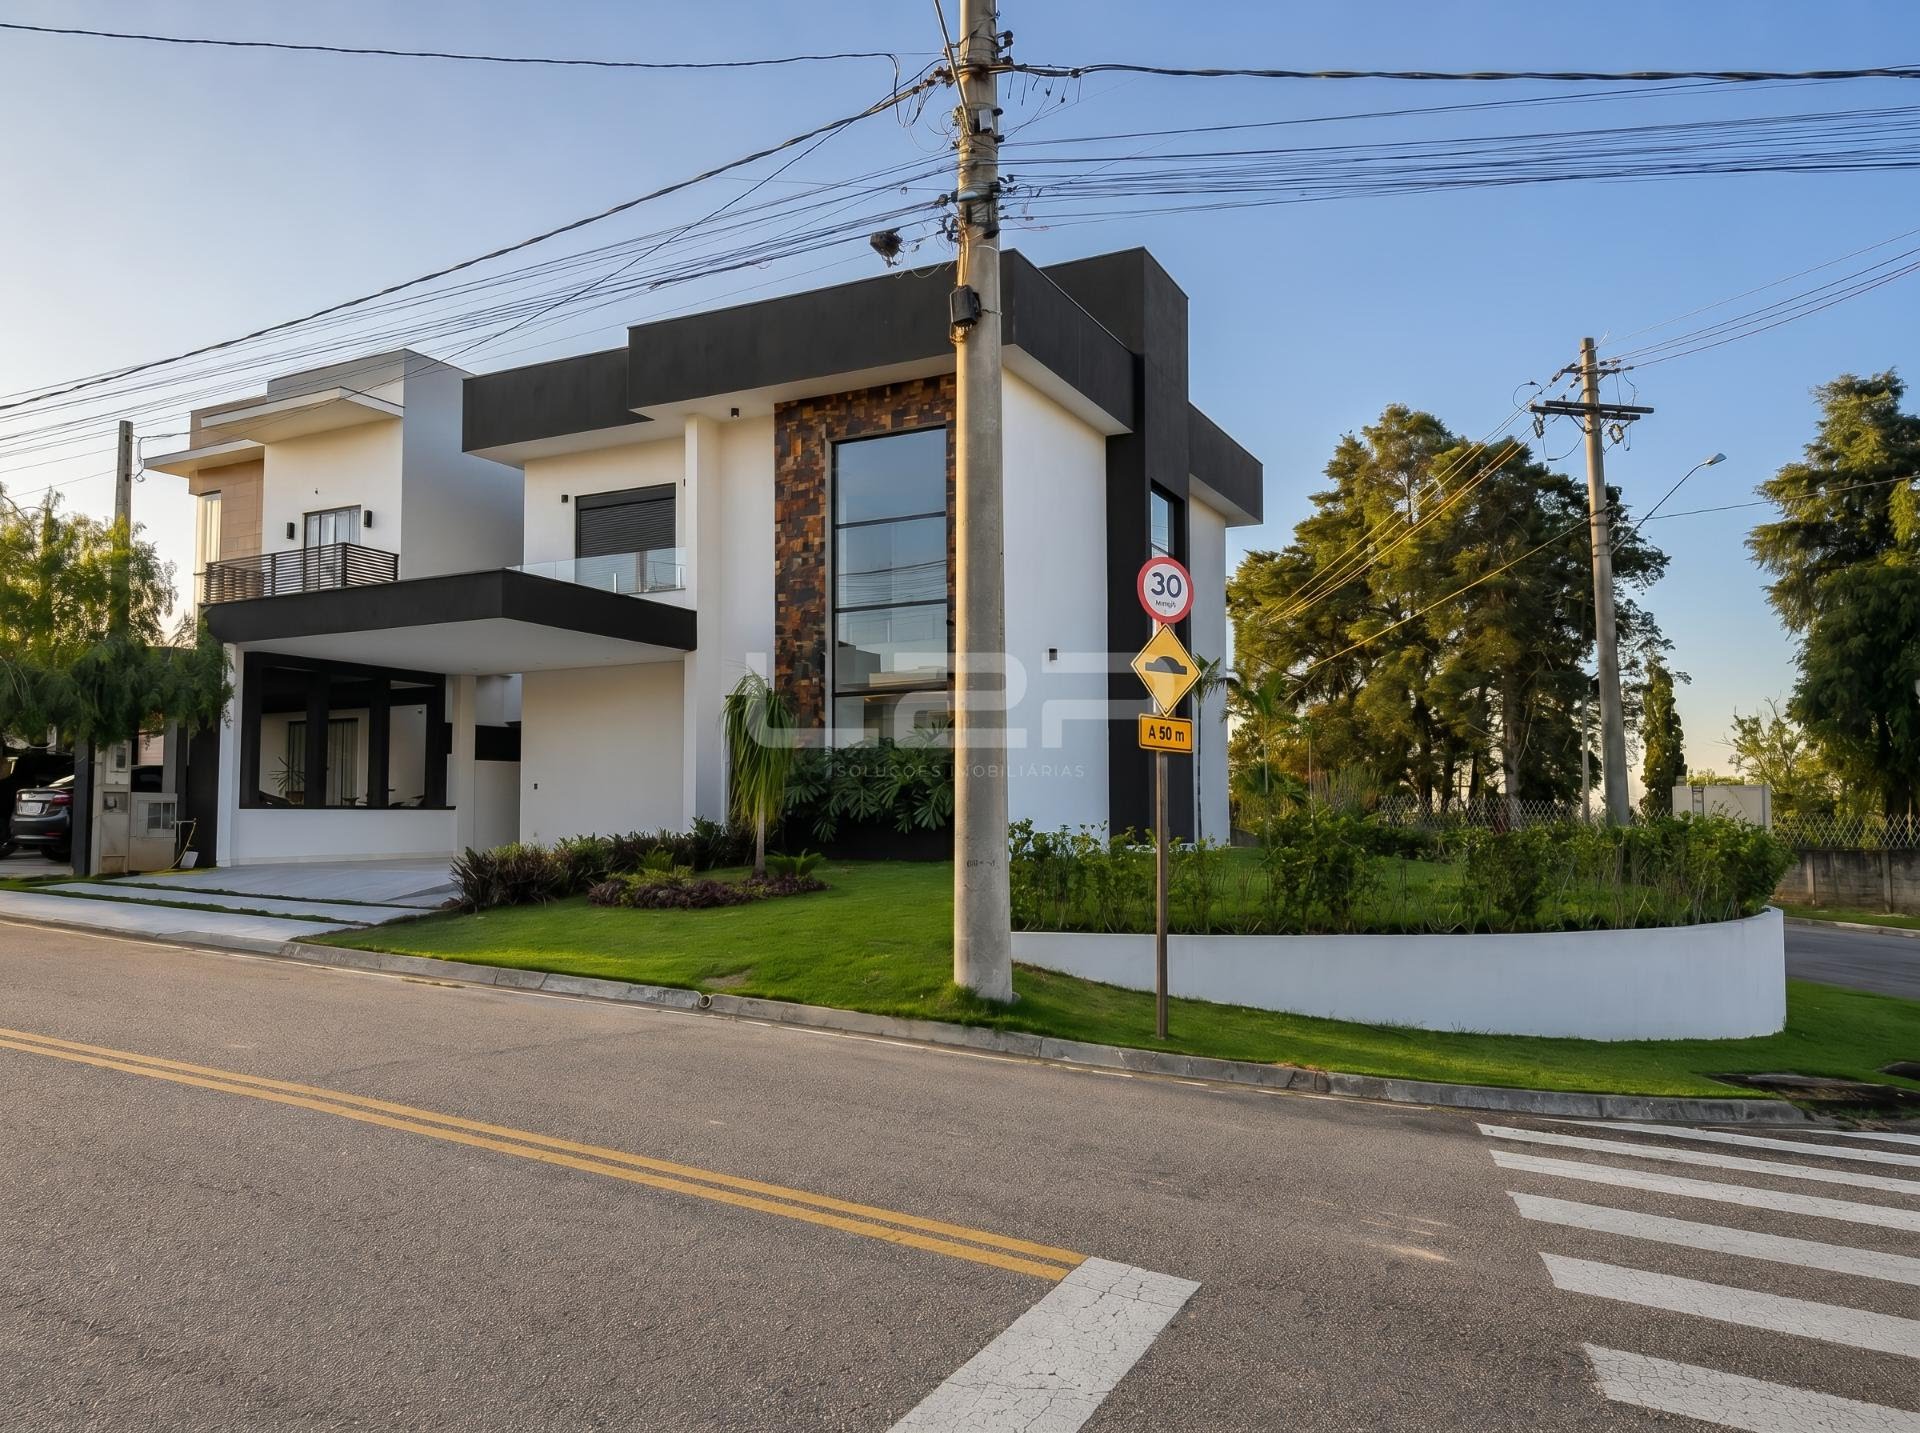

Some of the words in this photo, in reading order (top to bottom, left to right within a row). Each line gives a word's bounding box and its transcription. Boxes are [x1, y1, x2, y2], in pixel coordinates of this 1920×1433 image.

[1151, 571, 1182, 598] 30
[1148, 724, 1157, 740] A
[1159, 725, 1172, 741] 50
[1175, 730, 1185, 742] m
